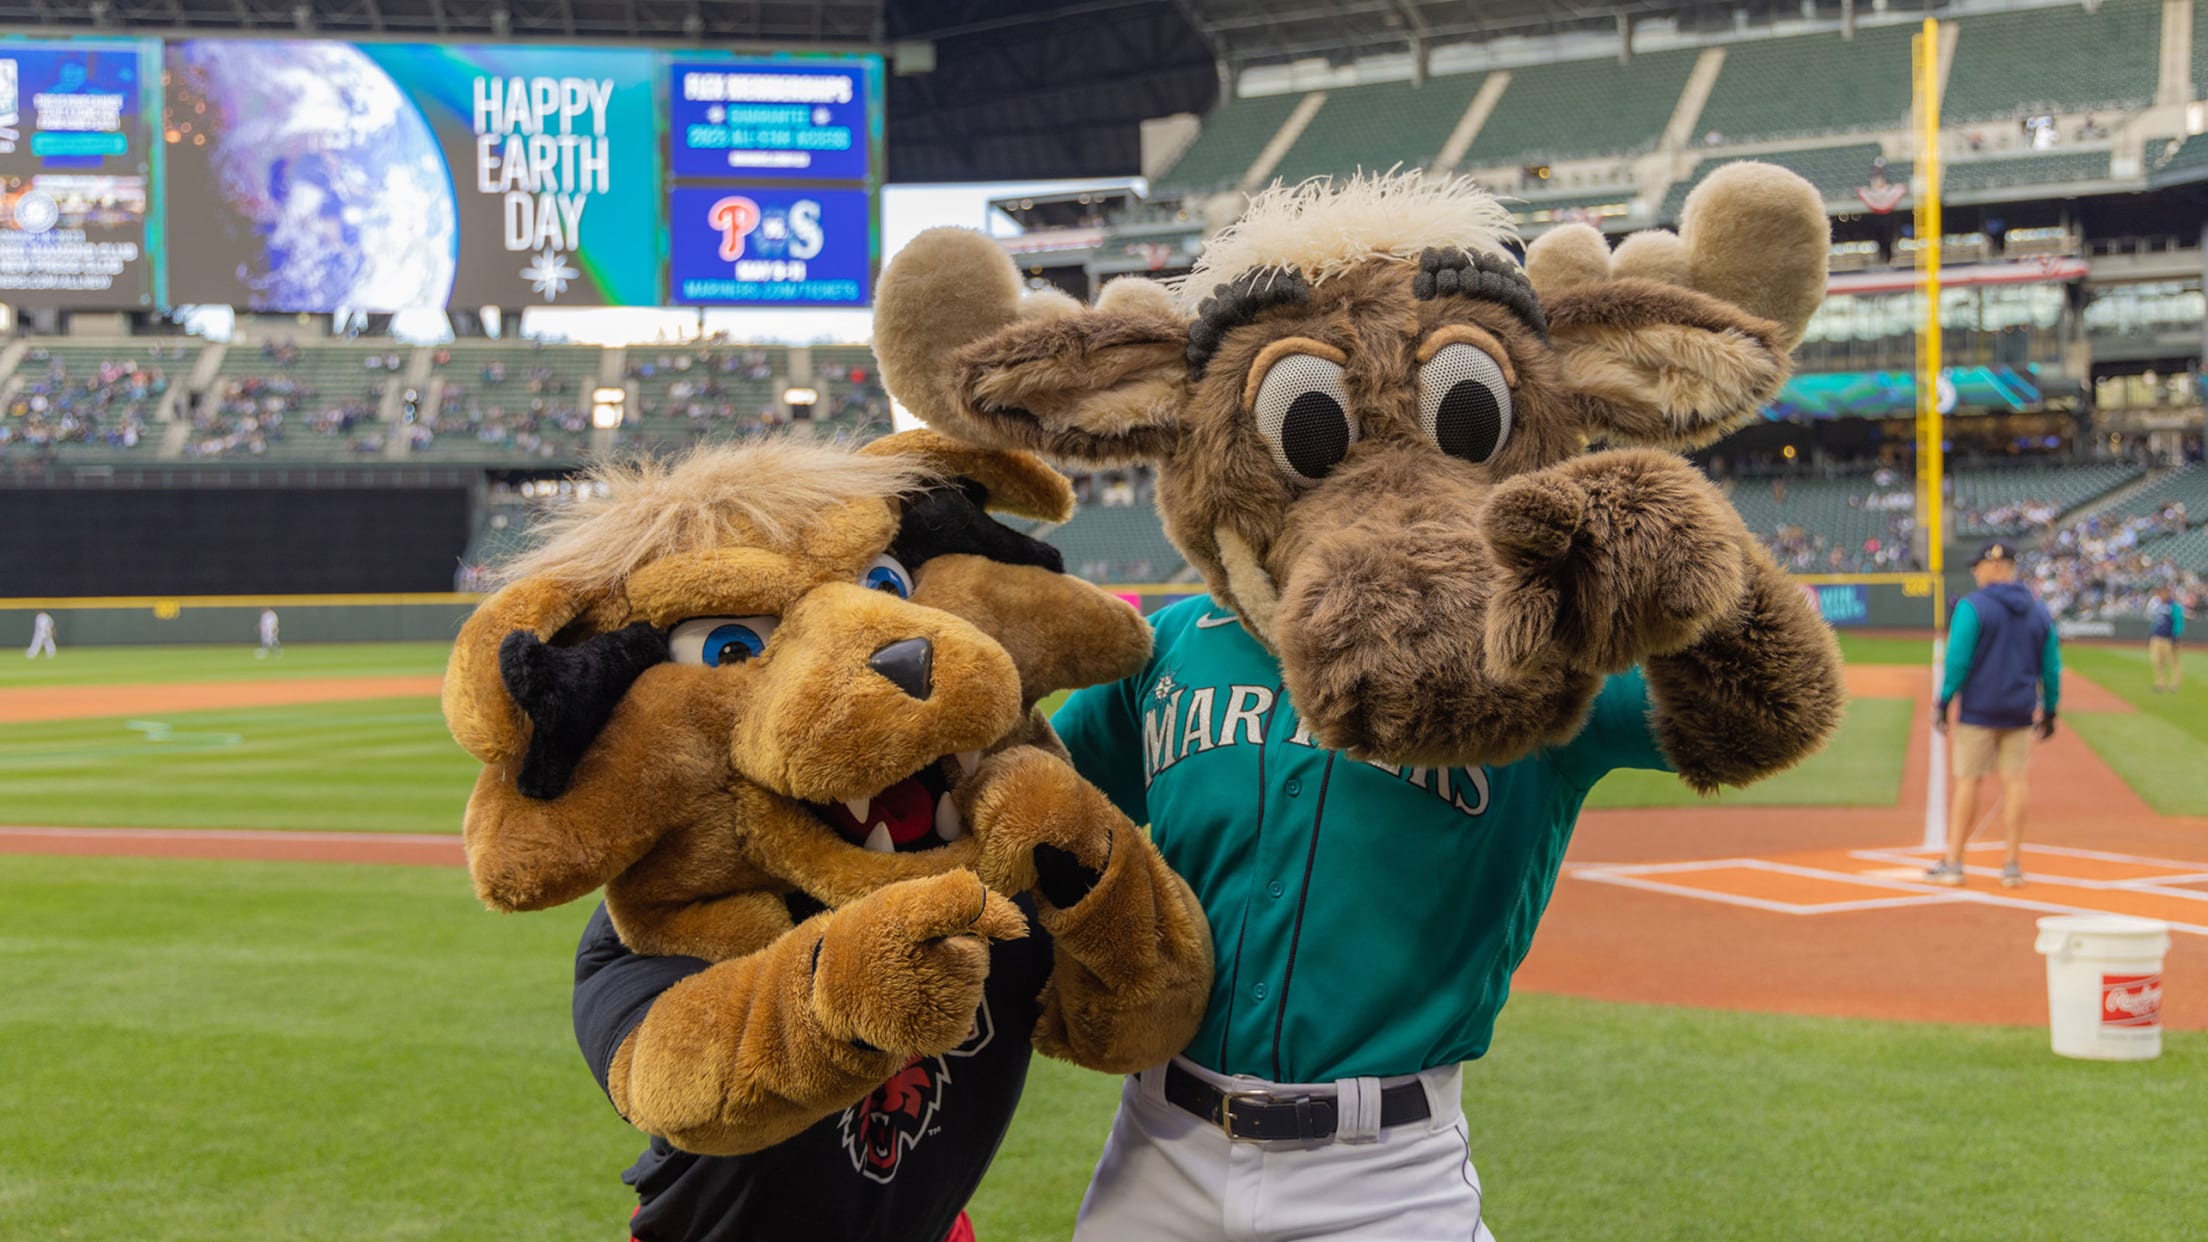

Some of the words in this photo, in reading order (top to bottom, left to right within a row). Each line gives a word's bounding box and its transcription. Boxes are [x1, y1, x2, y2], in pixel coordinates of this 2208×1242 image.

[473, 76, 614, 136] HAPPY
[477, 133, 609, 194] EARTH
[504, 191, 587, 251] DAY
[788, 199, 824, 260] S
